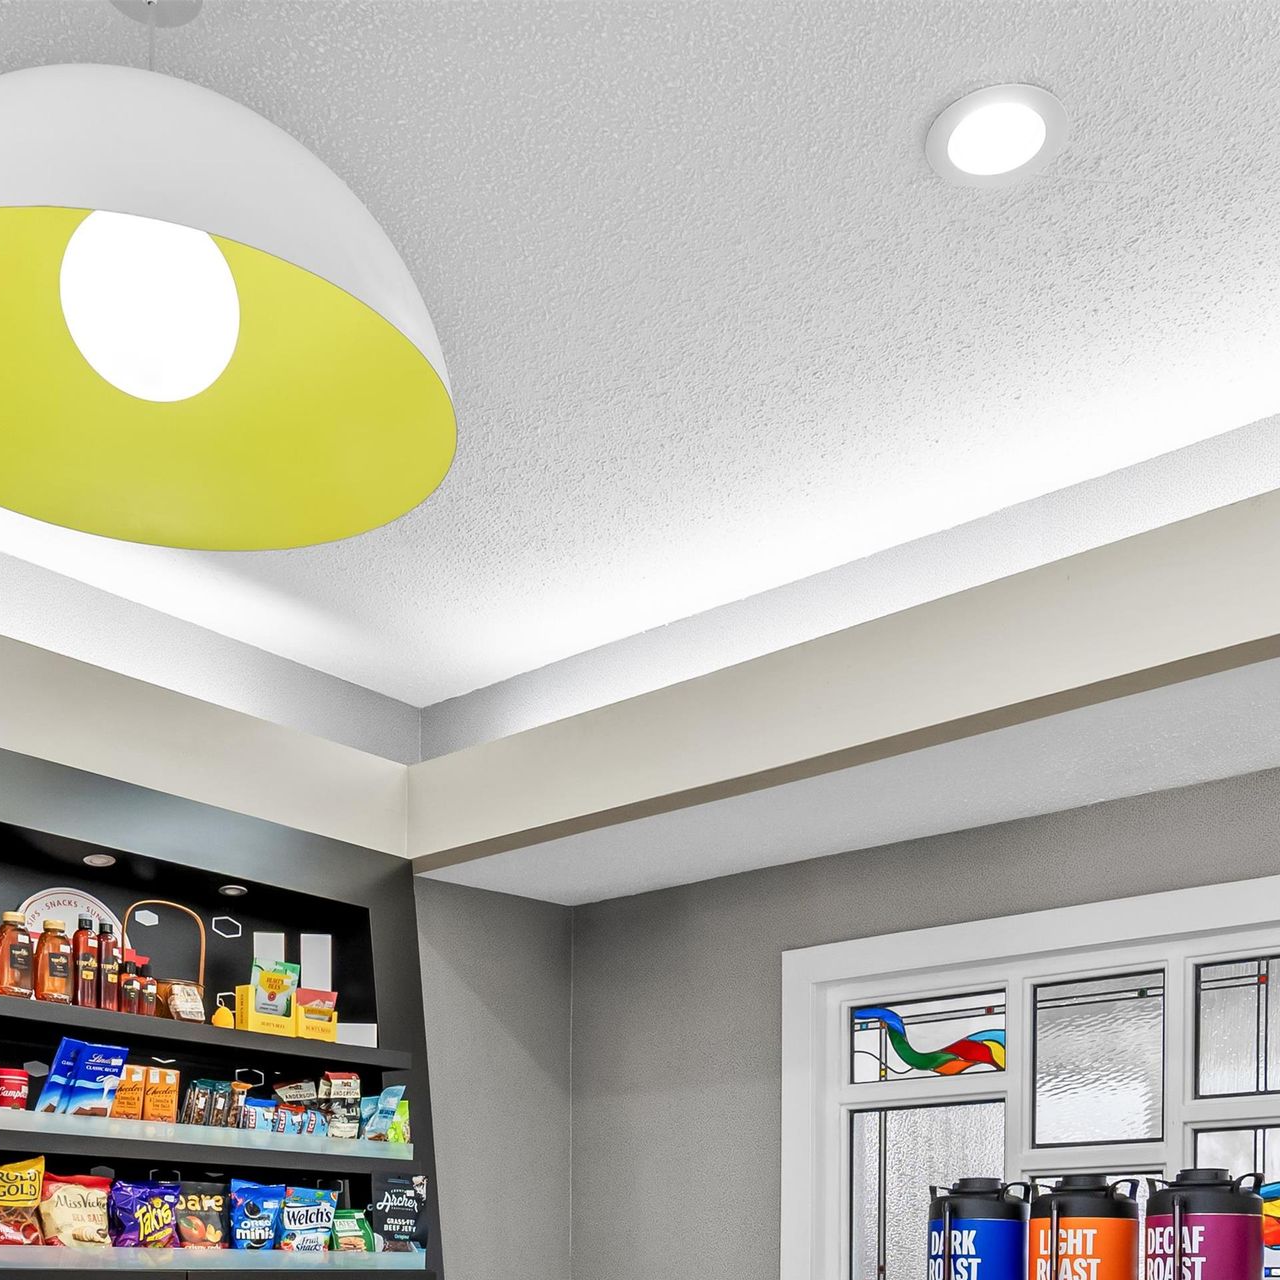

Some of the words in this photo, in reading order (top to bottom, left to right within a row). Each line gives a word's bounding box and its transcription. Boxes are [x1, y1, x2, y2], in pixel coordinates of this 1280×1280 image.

[26, 910, 42, 928] SIPS
[45, 899, 79, 911] SNACKS
[285, 1092, 315, 1101] ANDERSON
[55, 1195, 81, 1208] Miss
[376, 1191, 418, 1213] Archer
[135, 1203, 173, 1241] Takis
[286, 1207, 332, 1226] Welch's
[236, 1226, 273, 1240] minis
[301, 1235, 319, 1245] Fruit
[1147, 1226, 1205, 1254] DECAF
[296, 1241, 323, 1251] Snacks
